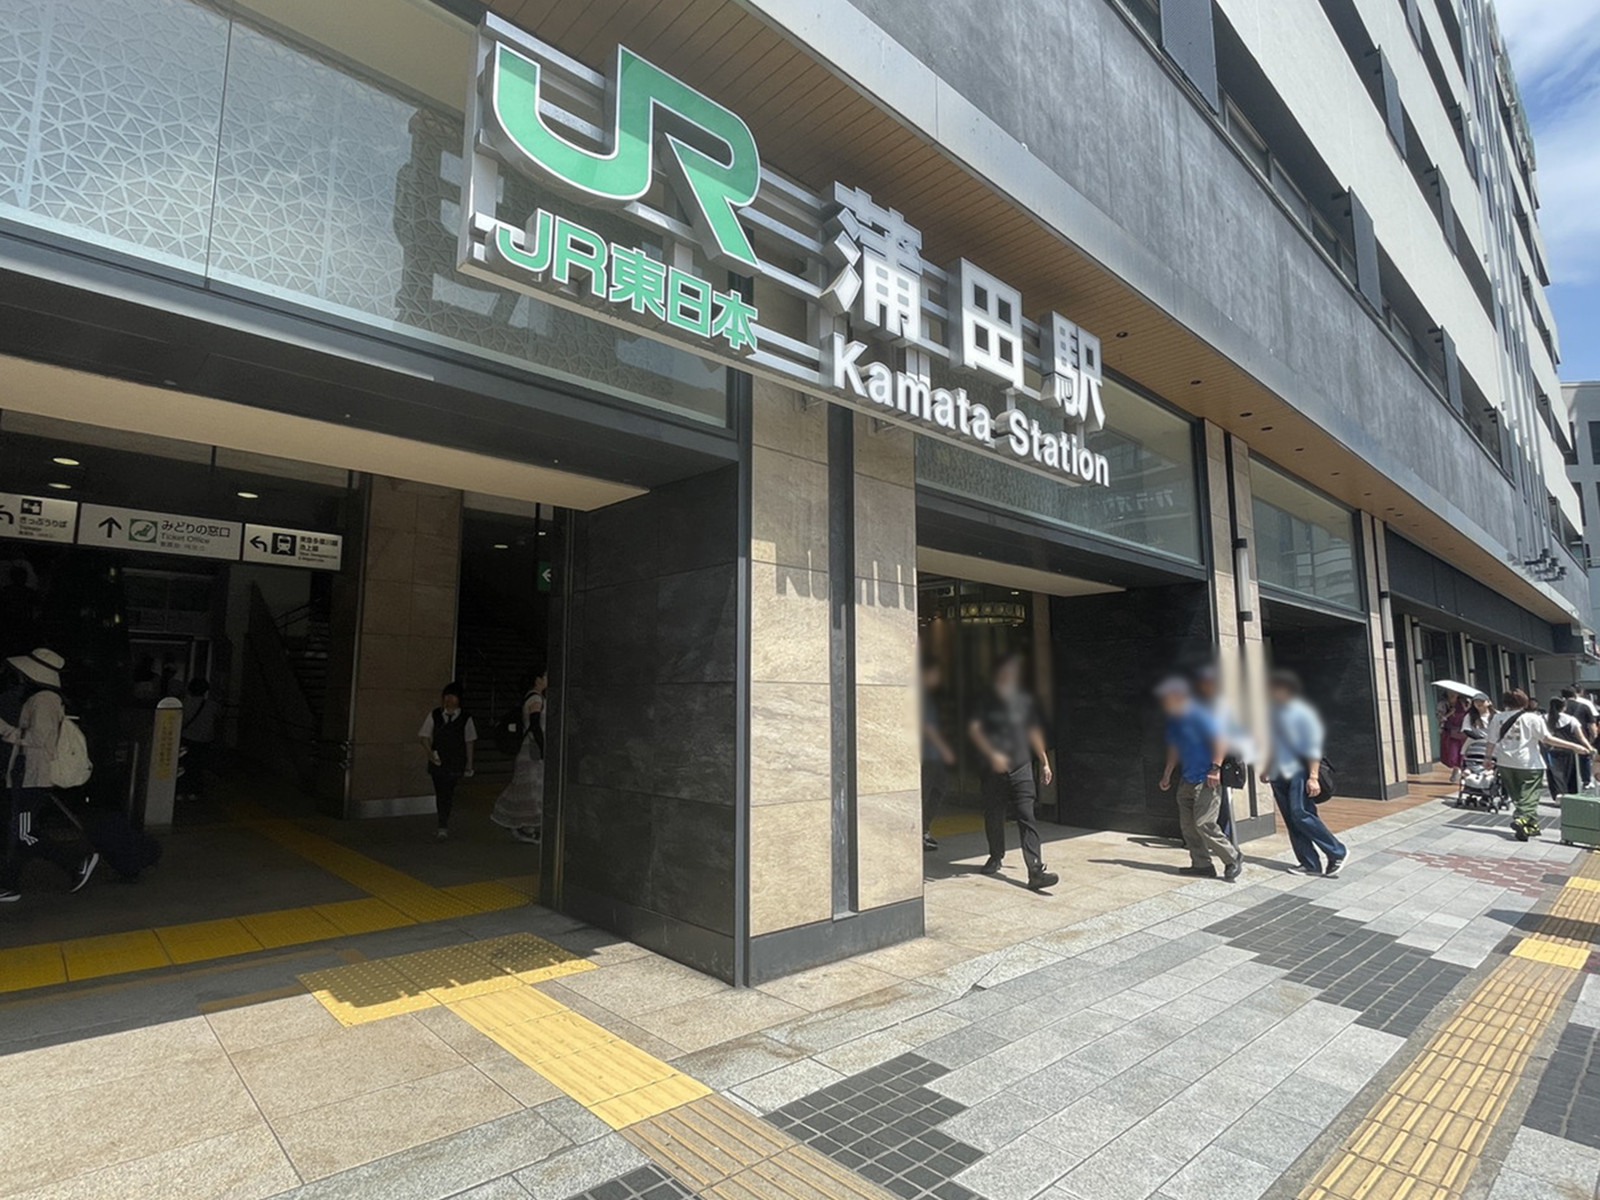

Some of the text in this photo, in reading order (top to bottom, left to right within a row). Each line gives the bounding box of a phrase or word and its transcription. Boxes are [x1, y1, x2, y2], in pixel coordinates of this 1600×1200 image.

[493, 42, 761, 268] JR
[495, 207, 758, 352] JR東日本
[833, 180, 1106, 430] 蒲田駅
[832, 331, 1110, 487] Kamata Station
[161, 520, 231, 537] みどりの窓口
